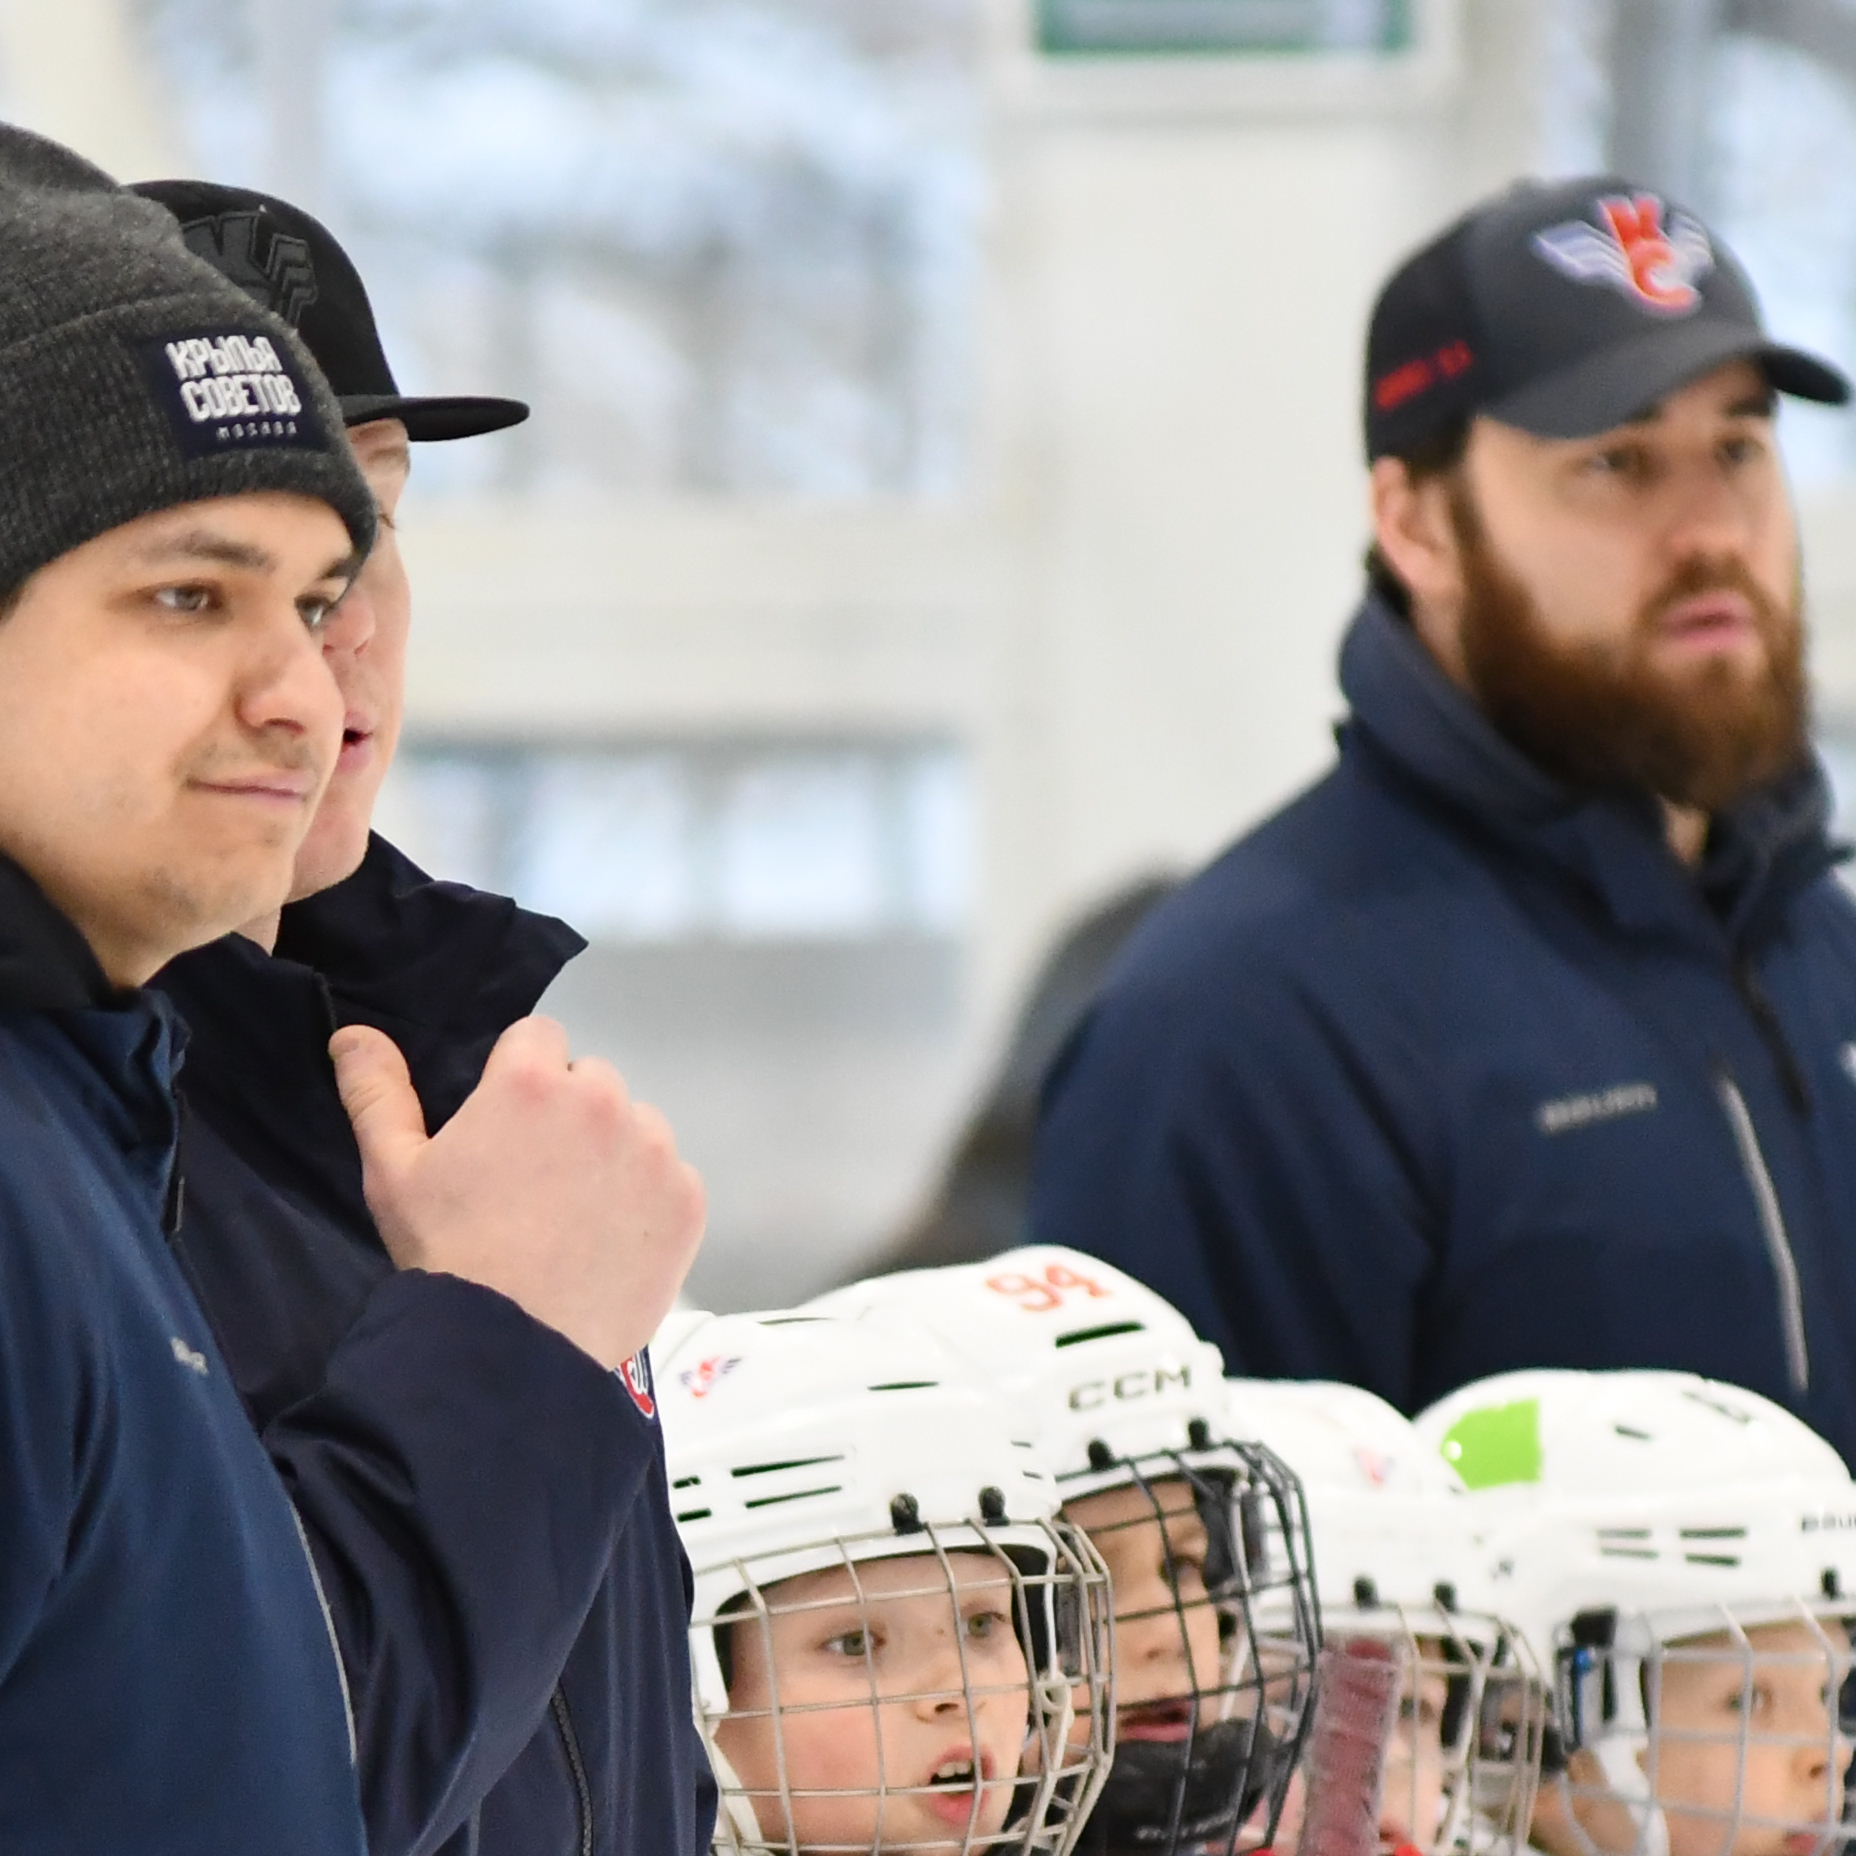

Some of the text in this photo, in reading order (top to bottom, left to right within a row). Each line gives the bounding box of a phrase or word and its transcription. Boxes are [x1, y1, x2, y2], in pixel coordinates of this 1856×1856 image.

[164, 334, 283, 382] КРЫЛЬЯ
[180, 373, 302, 423] СОВЕТОВ
[1067, 1364, 1192, 1412] CCM
